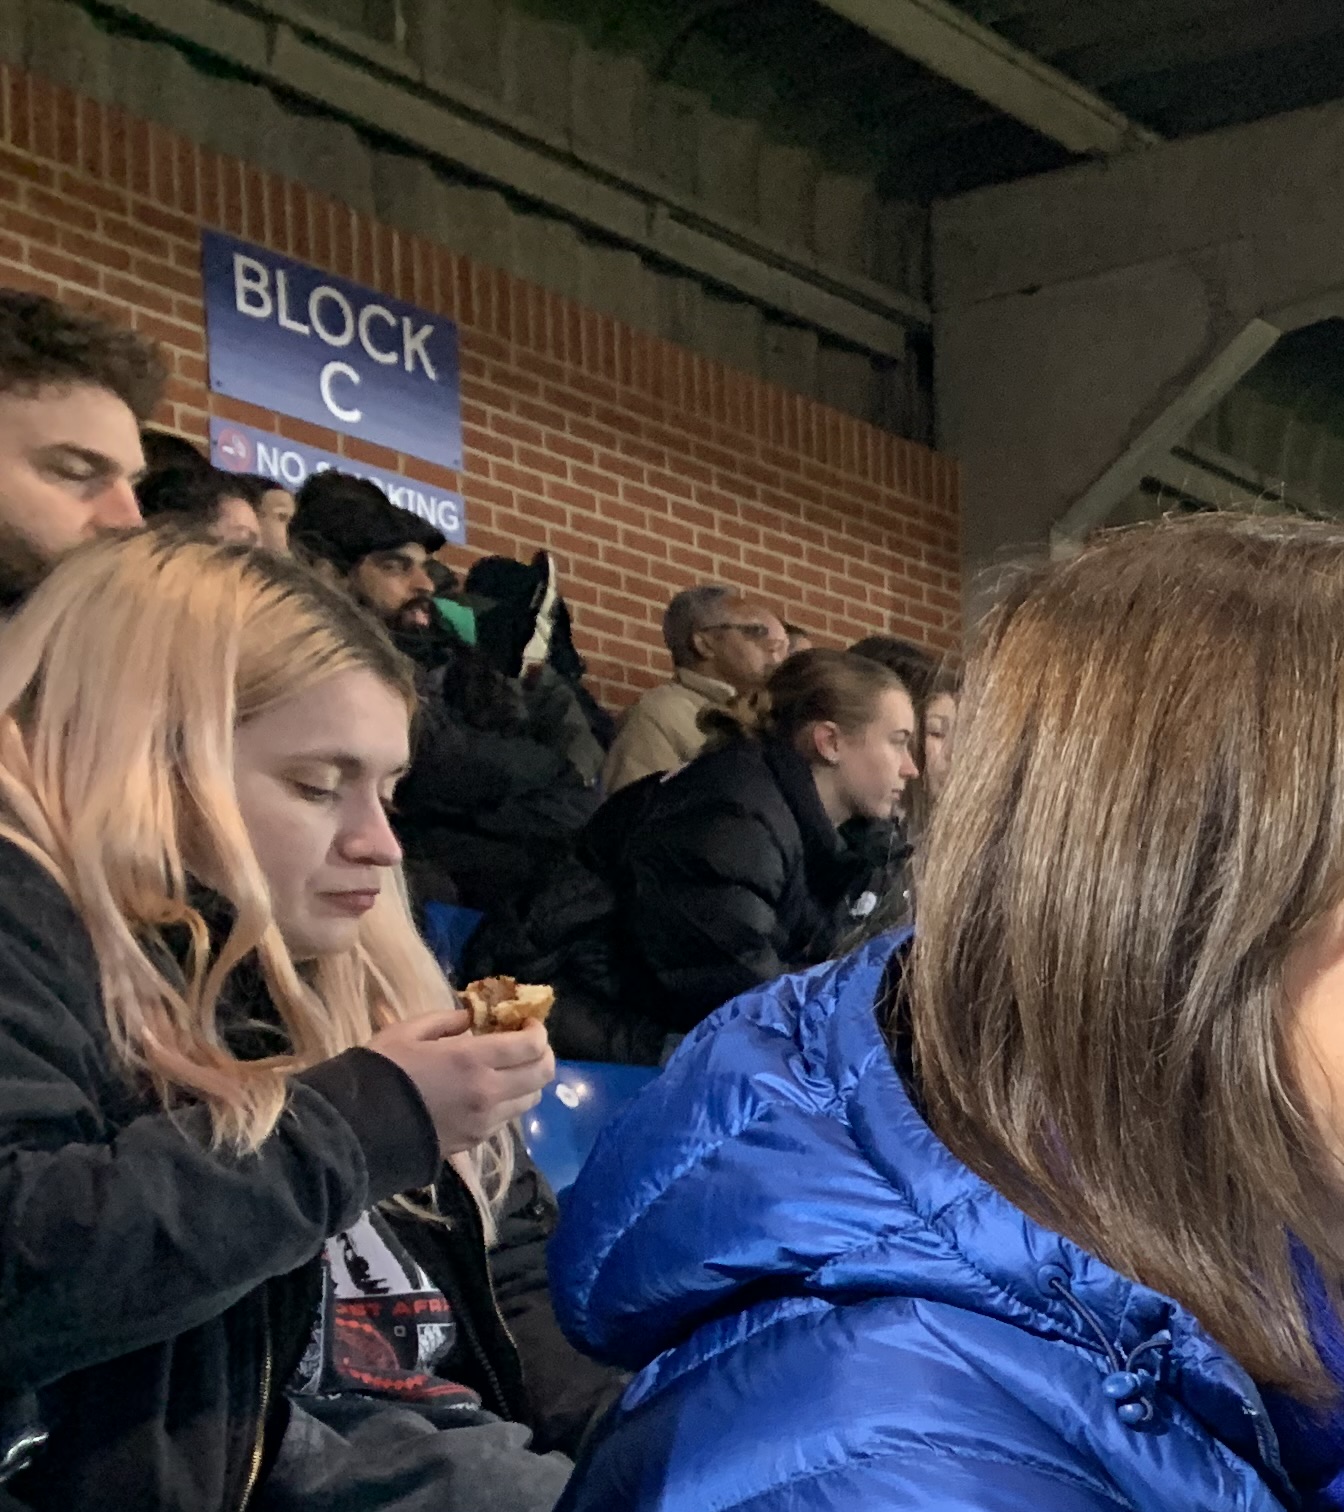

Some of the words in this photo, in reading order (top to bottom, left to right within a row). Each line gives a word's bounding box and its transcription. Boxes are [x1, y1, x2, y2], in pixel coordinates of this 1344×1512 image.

[233, 252, 437, 382] BLOCK
[319, 361, 363, 423] C
[256, 442, 306, 487] NO
[316, 461, 460, 531] KING
